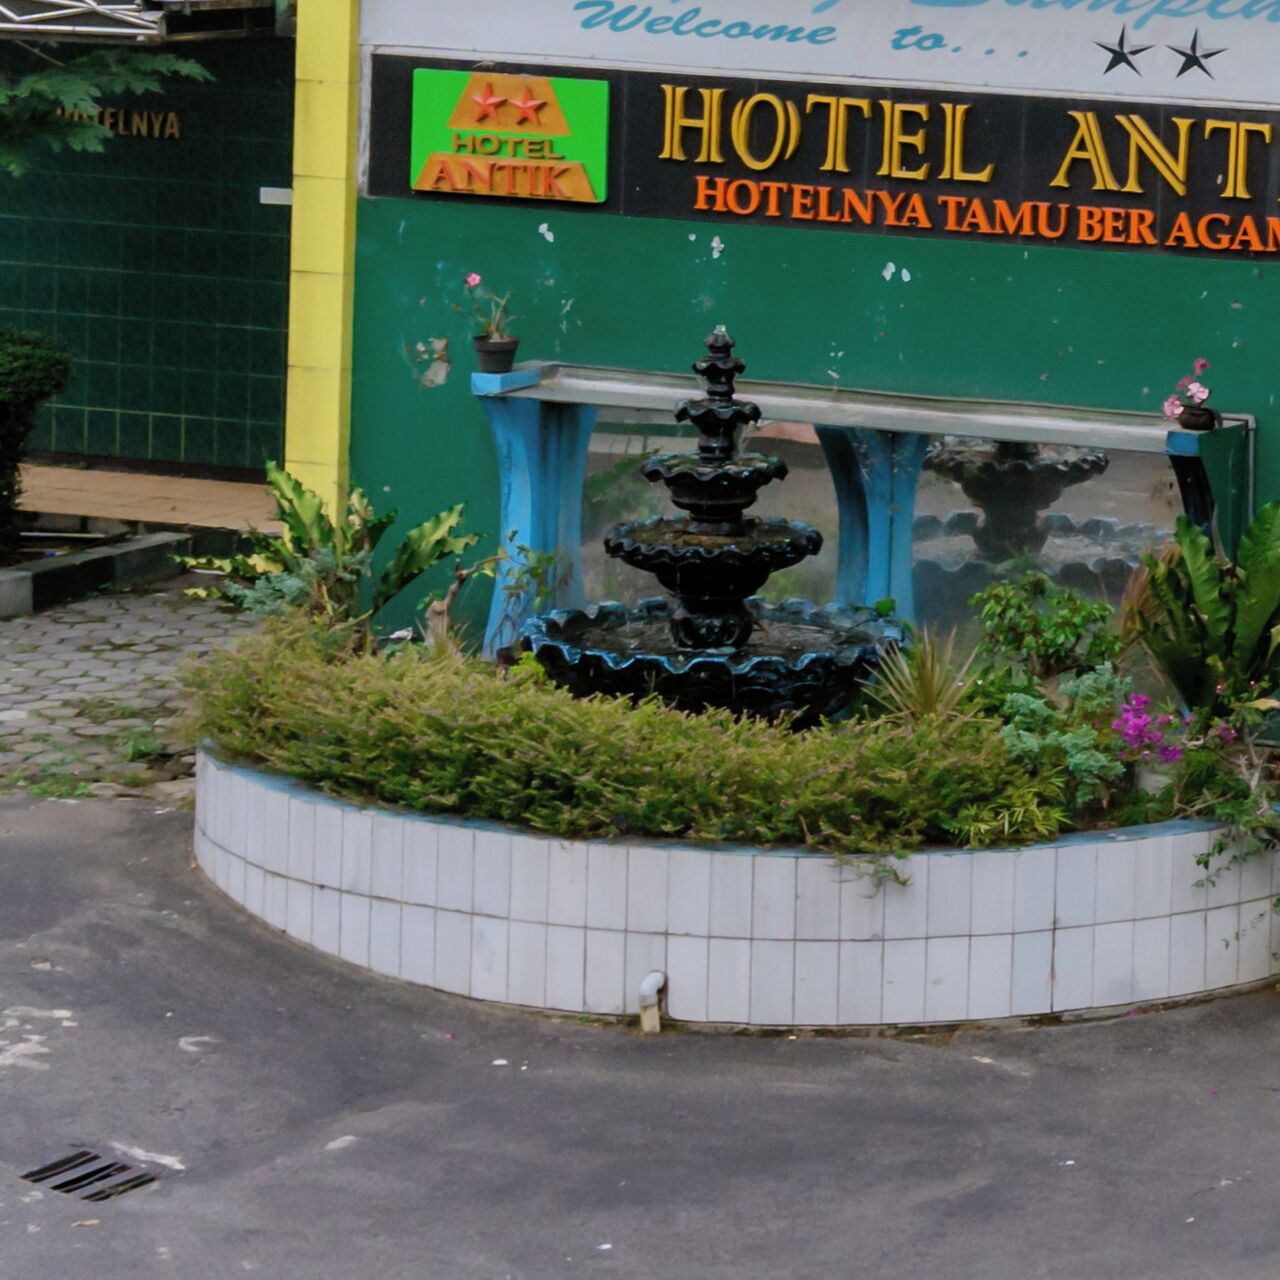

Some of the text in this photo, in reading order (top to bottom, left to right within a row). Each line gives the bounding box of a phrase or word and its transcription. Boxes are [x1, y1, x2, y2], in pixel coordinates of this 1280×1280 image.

[572, 0, 836, 46] Welcome
[452, 133, 565, 160] HOTEL
[658, 84, 995, 183] HOTEL
[431, 159, 573, 199] ANTIK
[693, 176, 932, 229] HOTELNYA
[938, 195, 1070, 239] TAMU
[1076, 205, 1158, 245] BER
